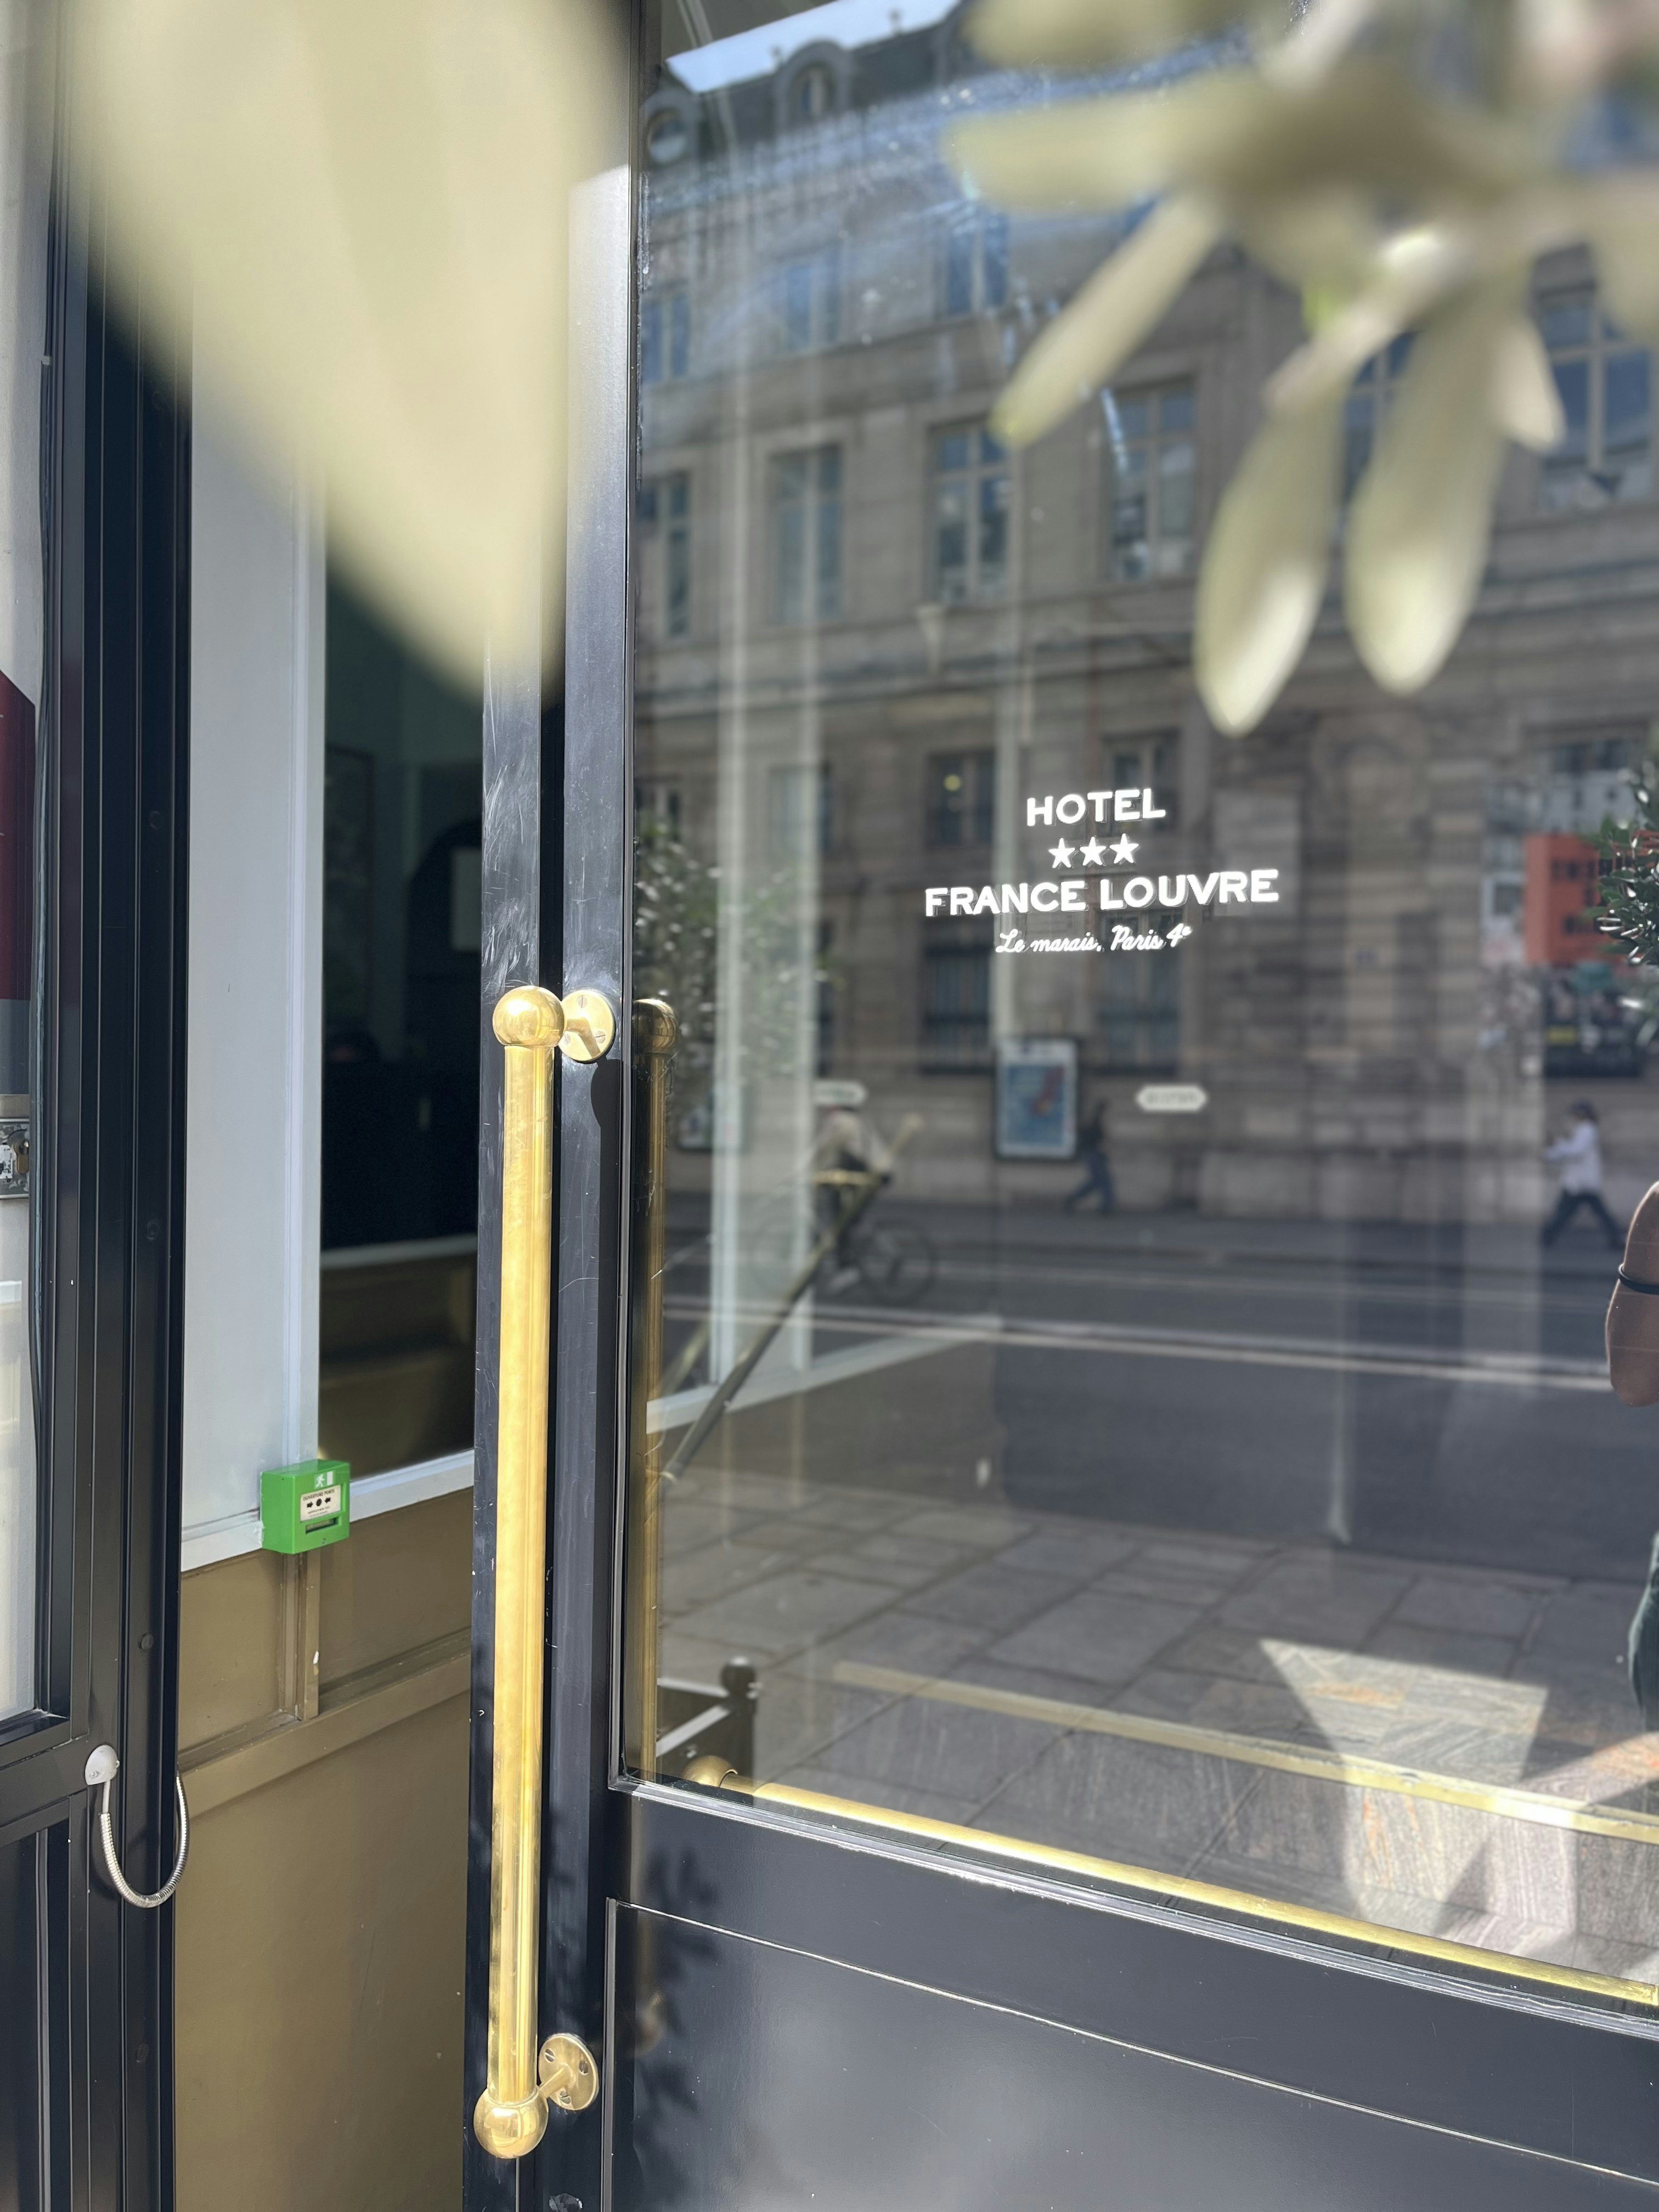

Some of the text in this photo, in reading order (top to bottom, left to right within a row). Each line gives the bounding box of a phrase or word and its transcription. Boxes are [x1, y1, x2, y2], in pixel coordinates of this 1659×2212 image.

[1027, 788, 1166, 826] HOTEL
[925, 869, 1279, 917] FRANCE LOUVRE
[995, 928, 1025, 953] Le
[1110, 924, 1164, 951] Paris
